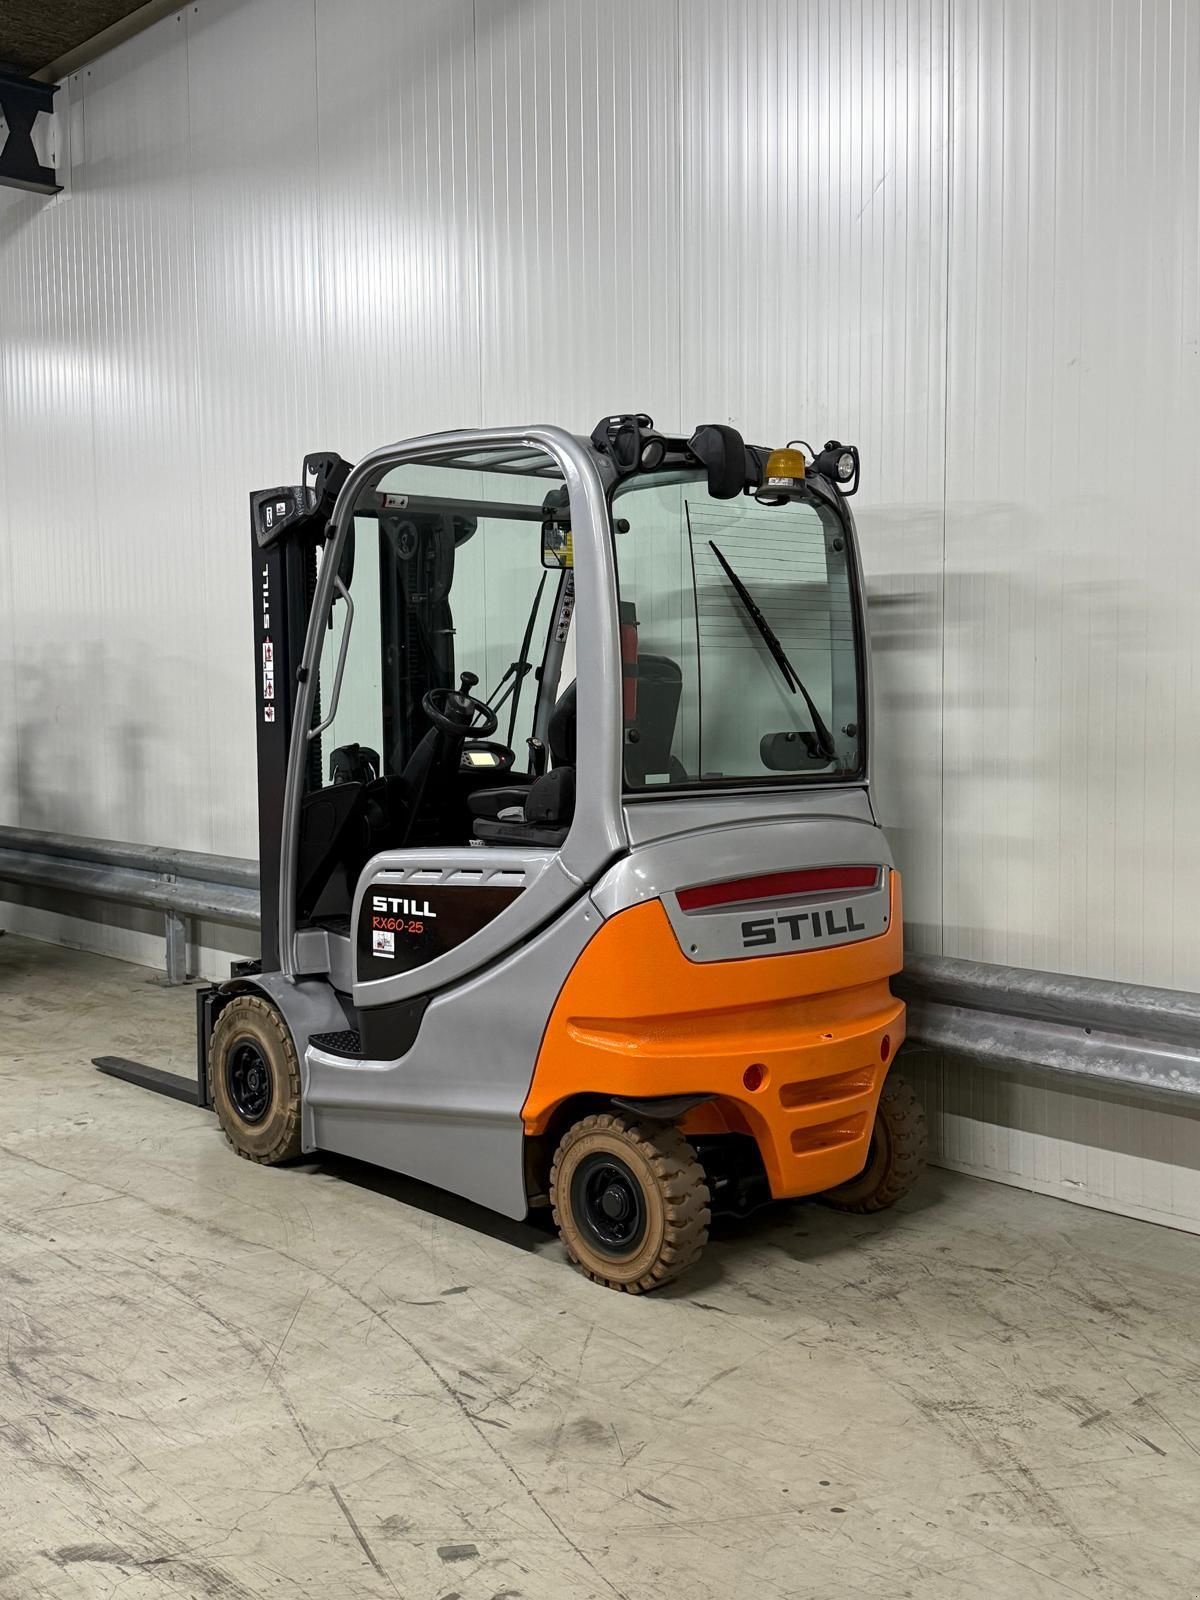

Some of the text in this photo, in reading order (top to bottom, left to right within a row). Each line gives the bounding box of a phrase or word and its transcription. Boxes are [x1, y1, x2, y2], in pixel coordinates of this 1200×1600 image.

[262, 563, 270, 629] STILL
[373, 896, 437, 917] STILL
[373, 916, 424, 934] RX60-25
[741, 907, 865, 948] STILL
